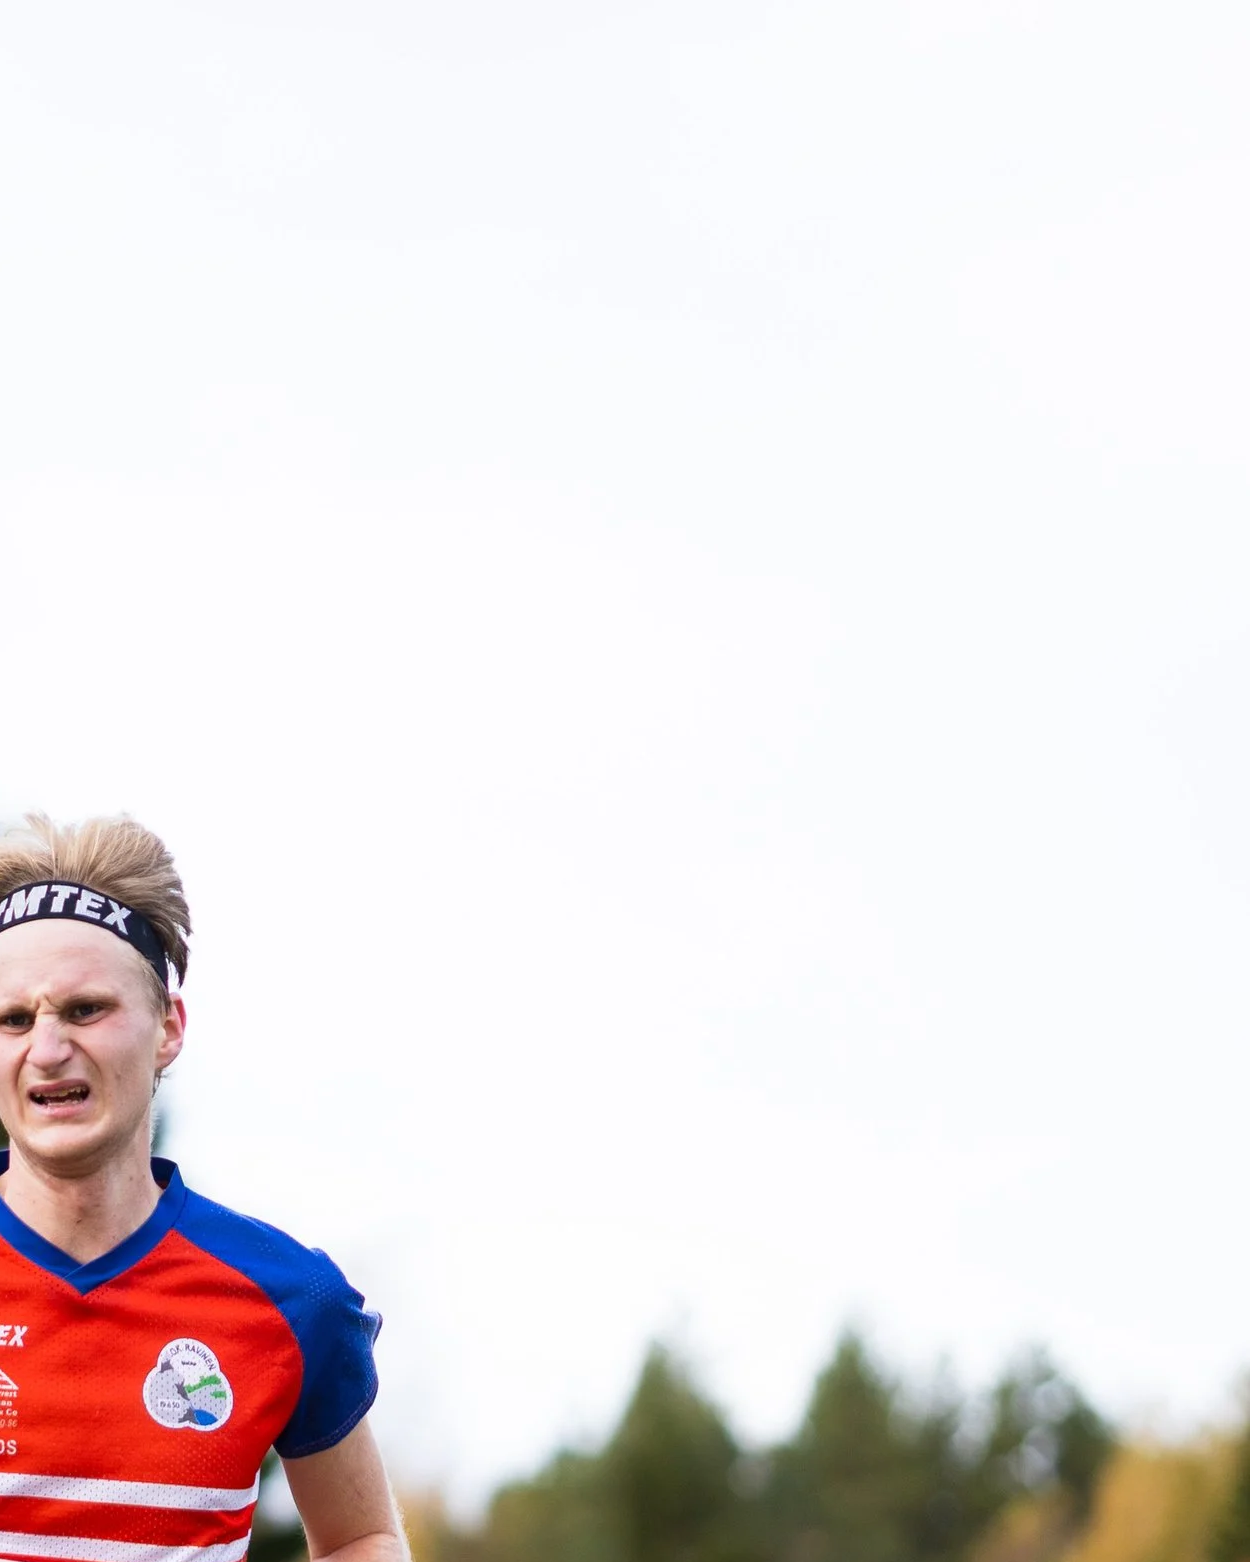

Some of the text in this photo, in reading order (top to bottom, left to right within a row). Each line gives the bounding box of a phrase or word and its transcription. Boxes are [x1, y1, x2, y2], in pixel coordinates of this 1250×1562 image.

[169, 1343, 216, 1371] OK RAVINEN
[6, 1408, 18, 1416] Co
